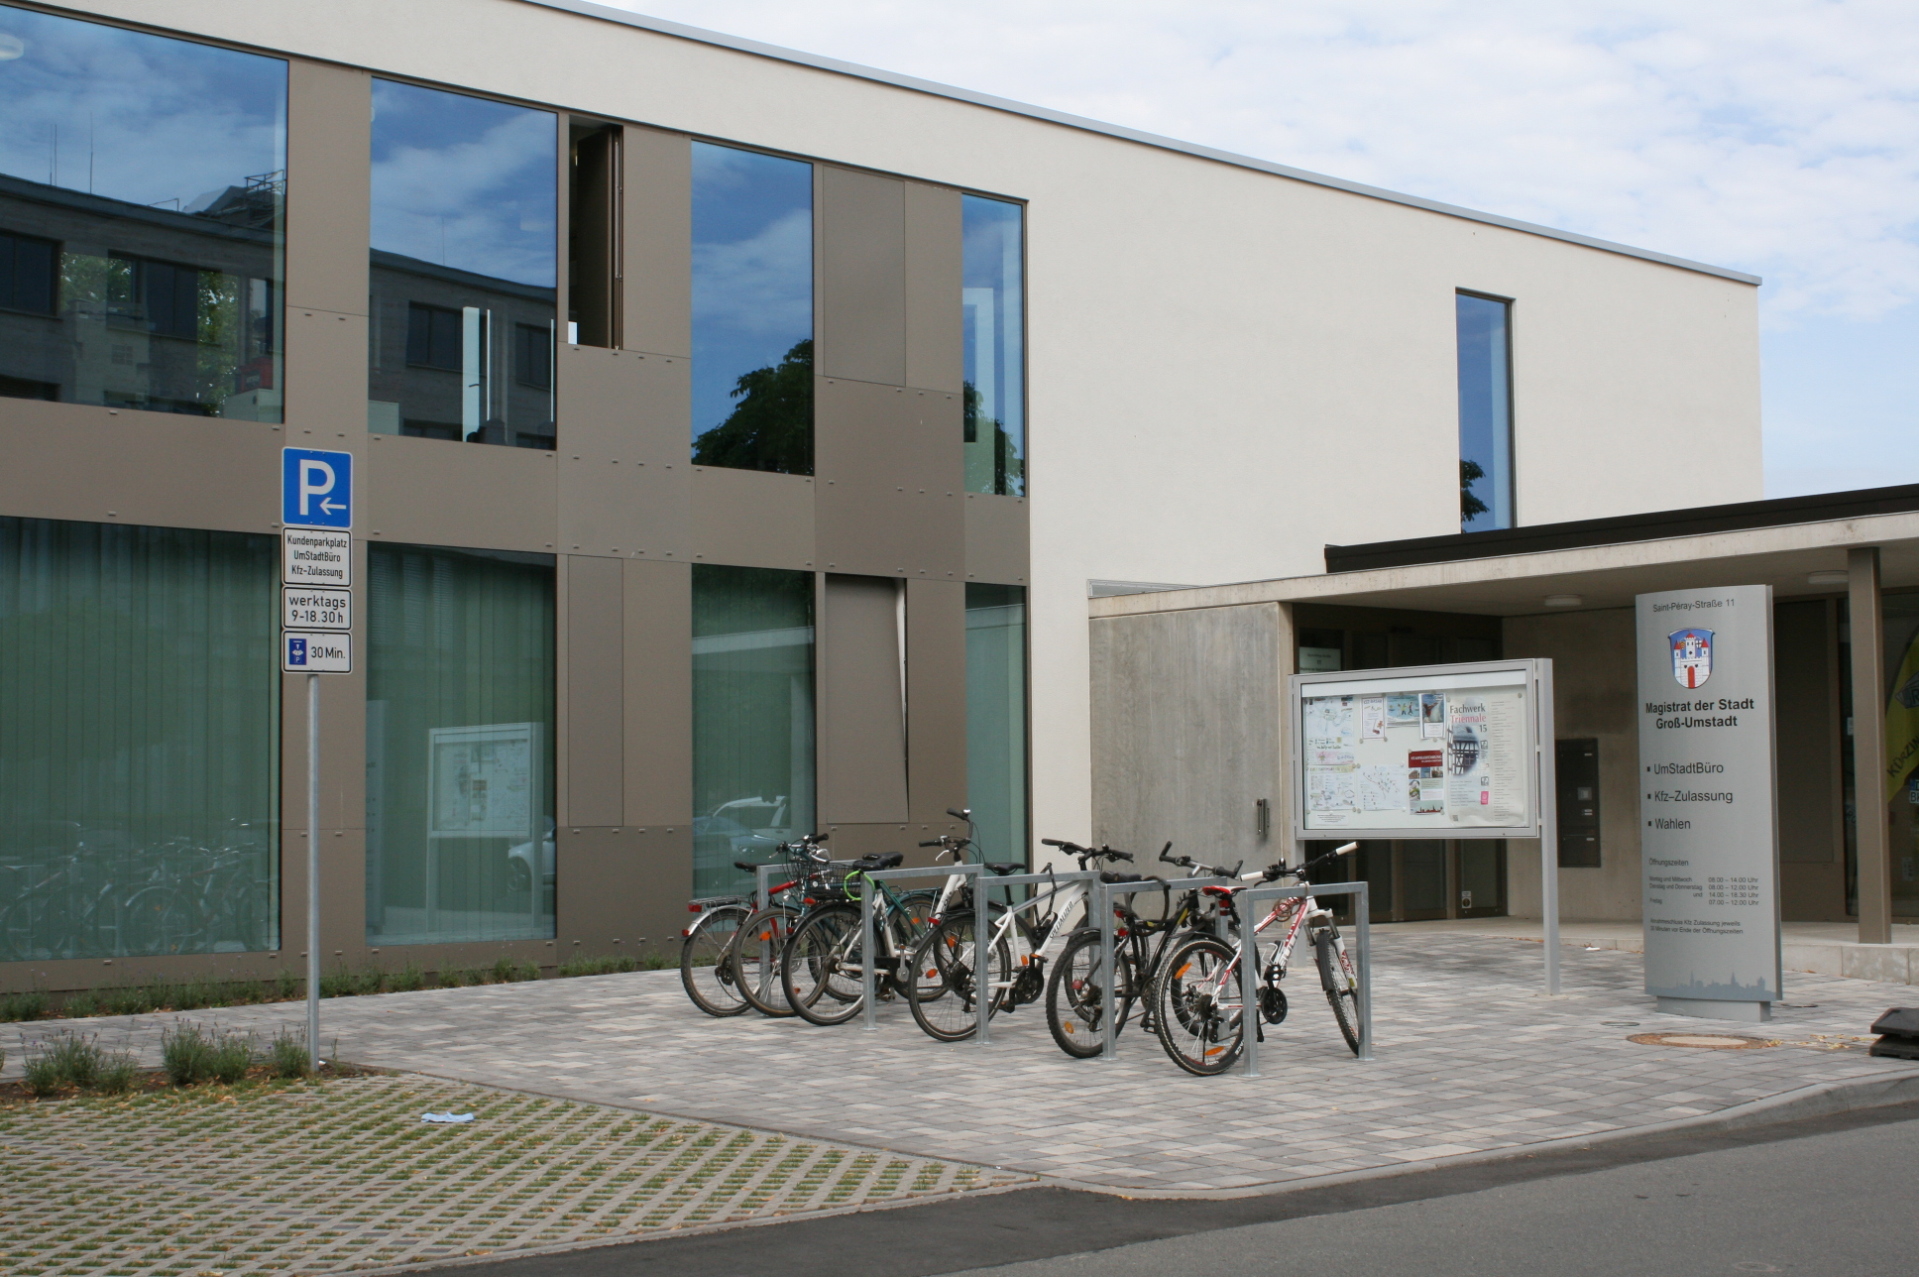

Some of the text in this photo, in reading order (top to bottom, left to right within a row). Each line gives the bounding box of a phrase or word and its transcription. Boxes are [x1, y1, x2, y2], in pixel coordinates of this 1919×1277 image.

[299, 459, 335, 516] P
[287, 535, 347, 549] Kundenparkplatz
[293, 550, 341, 562] UmStadtBüro
[291, 565, 343, 579] Kfz-Zulassung
[289, 595, 346, 610] werktags
[1653, 600, 1722, 612] Saint-Péray-Straße
[291, 609, 336, 623] 9-18.30
[311, 646, 346, 659] 30 Min.
[1450, 703, 1486, 714] Fachwerk
[1645, 698, 1755, 715] Magistrat der Stadt
[1451, 713, 1487, 723] Triennale
[1656, 715, 1738, 729] Groß-Umstadt
[1654, 762, 1724, 774] UmStadtBüro
[1655, 818, 1691, 829] Wahlen
[1649, 858, 1689, 867] Öffnungszeiten
